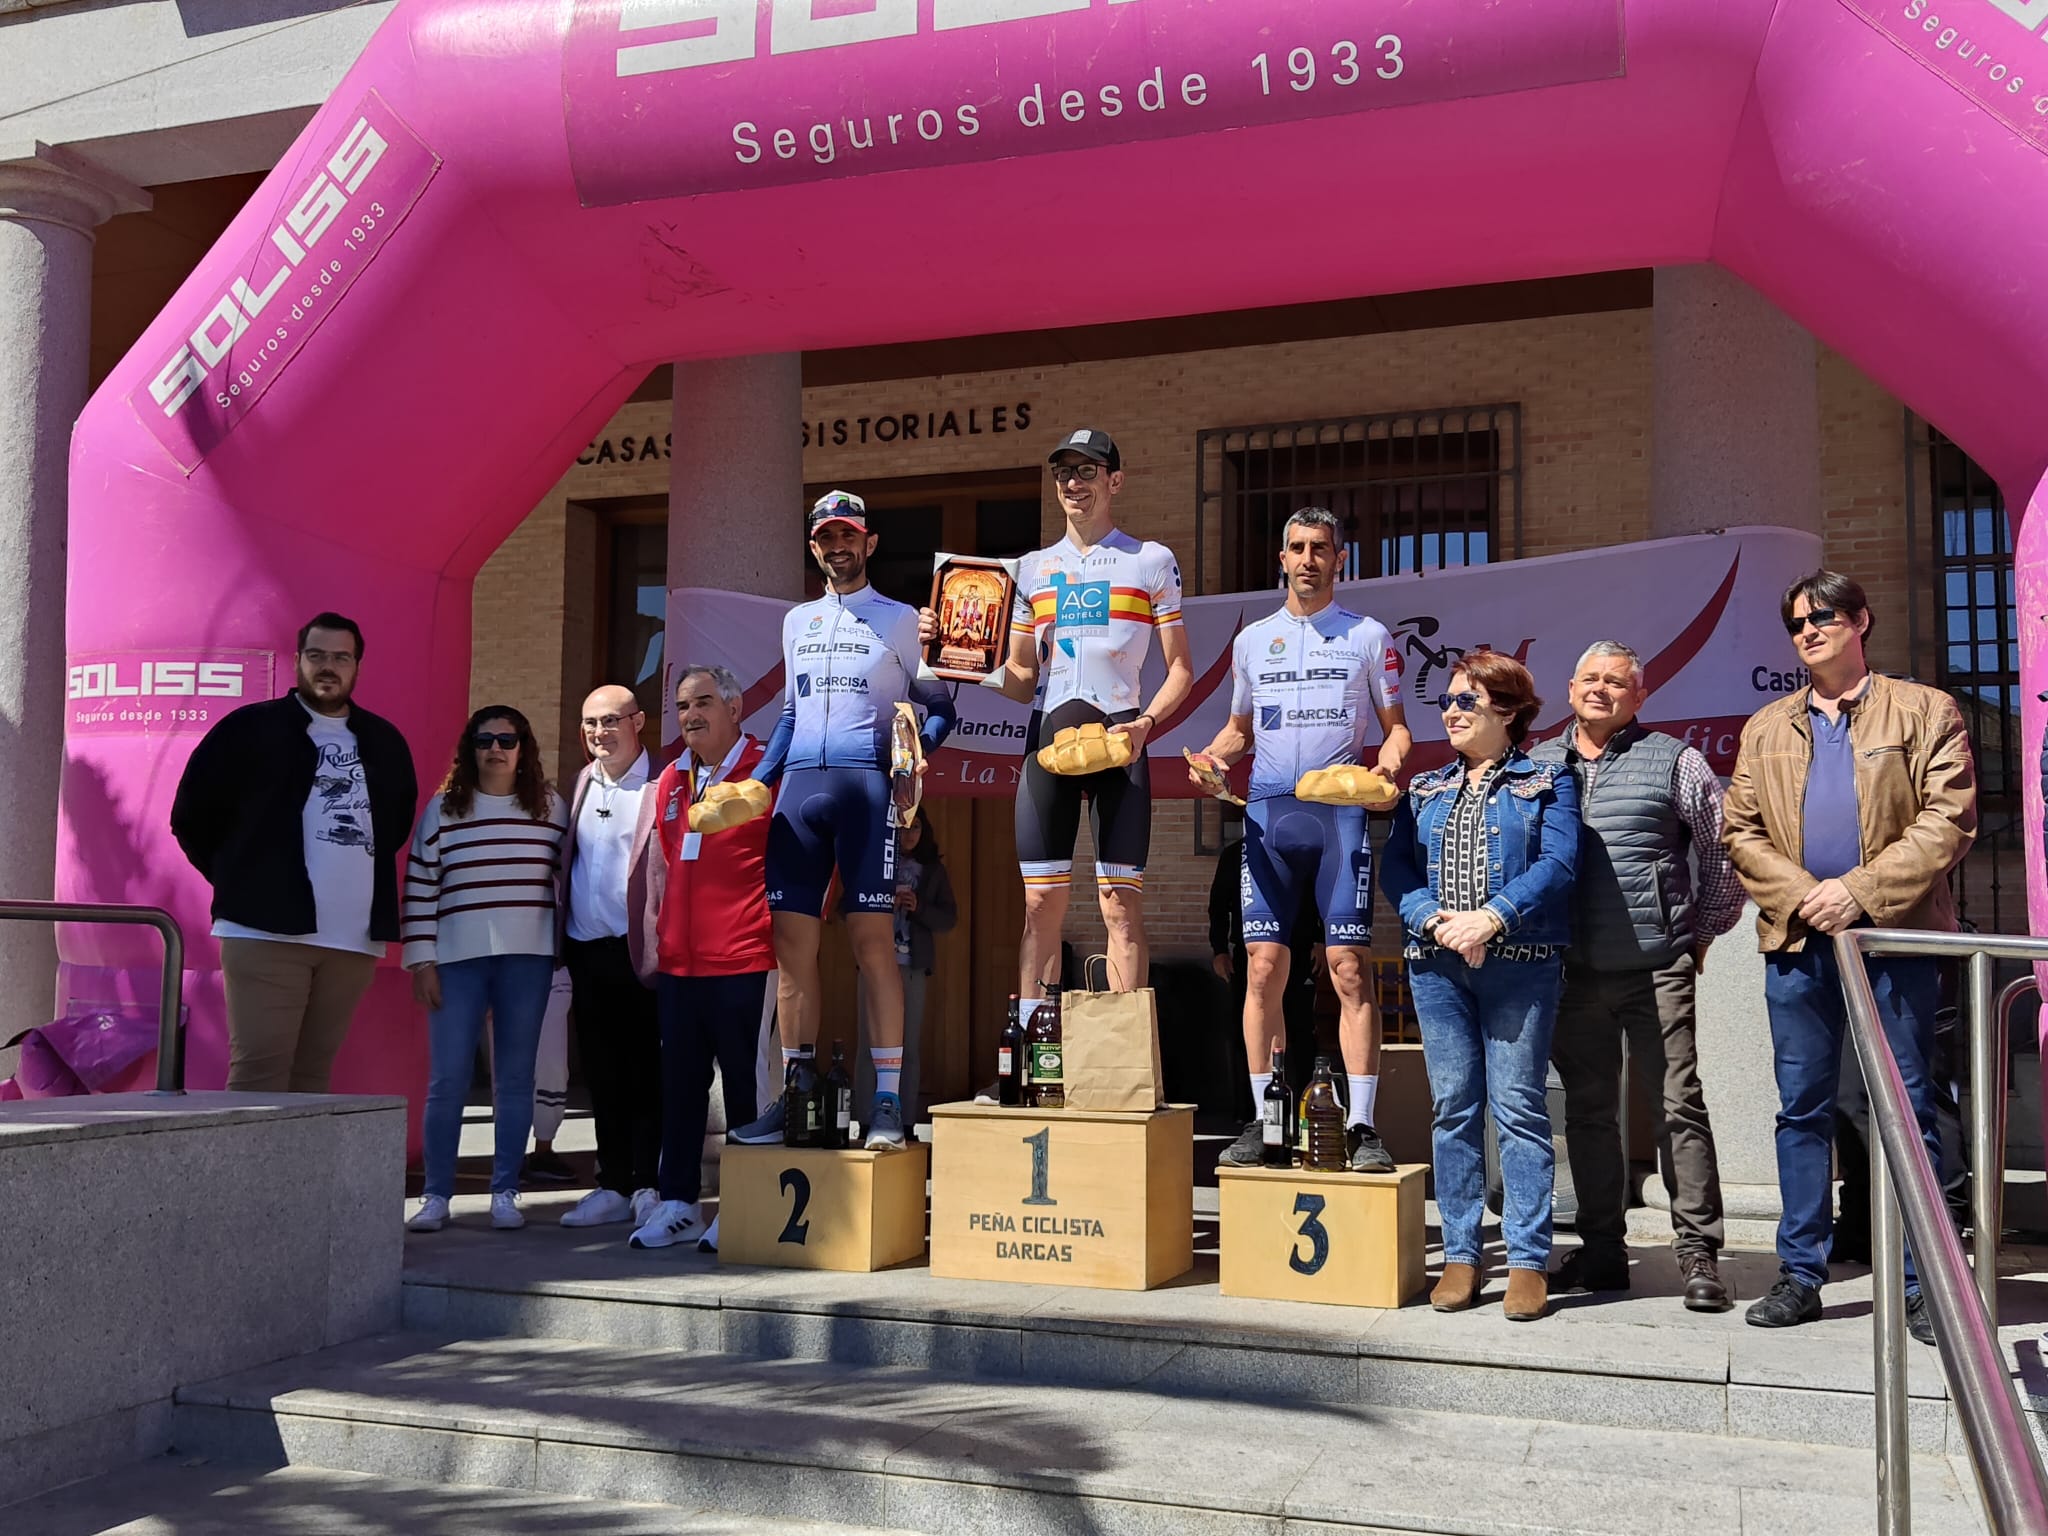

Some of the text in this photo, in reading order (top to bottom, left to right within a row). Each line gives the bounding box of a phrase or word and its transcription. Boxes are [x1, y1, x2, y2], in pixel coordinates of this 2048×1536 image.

[1904, 0, 2024, 93] Seguros
[732, 34, 1404, 164] Seguros desde 1933
[148, 116, 388, 418] SOLISS
[215, 202, 385, 408] Seguros desde 1933
[1061, 587, 1103, 610] AC
[1061, 611, 1103, 621] HOTELS
[797, 642, 871, 656] SOLISS
[68, 662, 243, 699] SOLISS
[815, 676, 869, 689] GARCISA
[1259, 667, 1349, 685] SOLISS
[76, 709, 208, 724] Seguros desde 1933
[1286, 708, 1349, 721] GARCISA
[960, 760, 996, 784] La
[1022, 1126, 1057, 1206] 1
[778, 1168, 811, 1246] 2
[970, 1212, 1105, 1238] PEÑA CICLISTA
[1289, 1191, 1329, 1276] 3
[996, 1241, 1073, 1263] BARGAS
